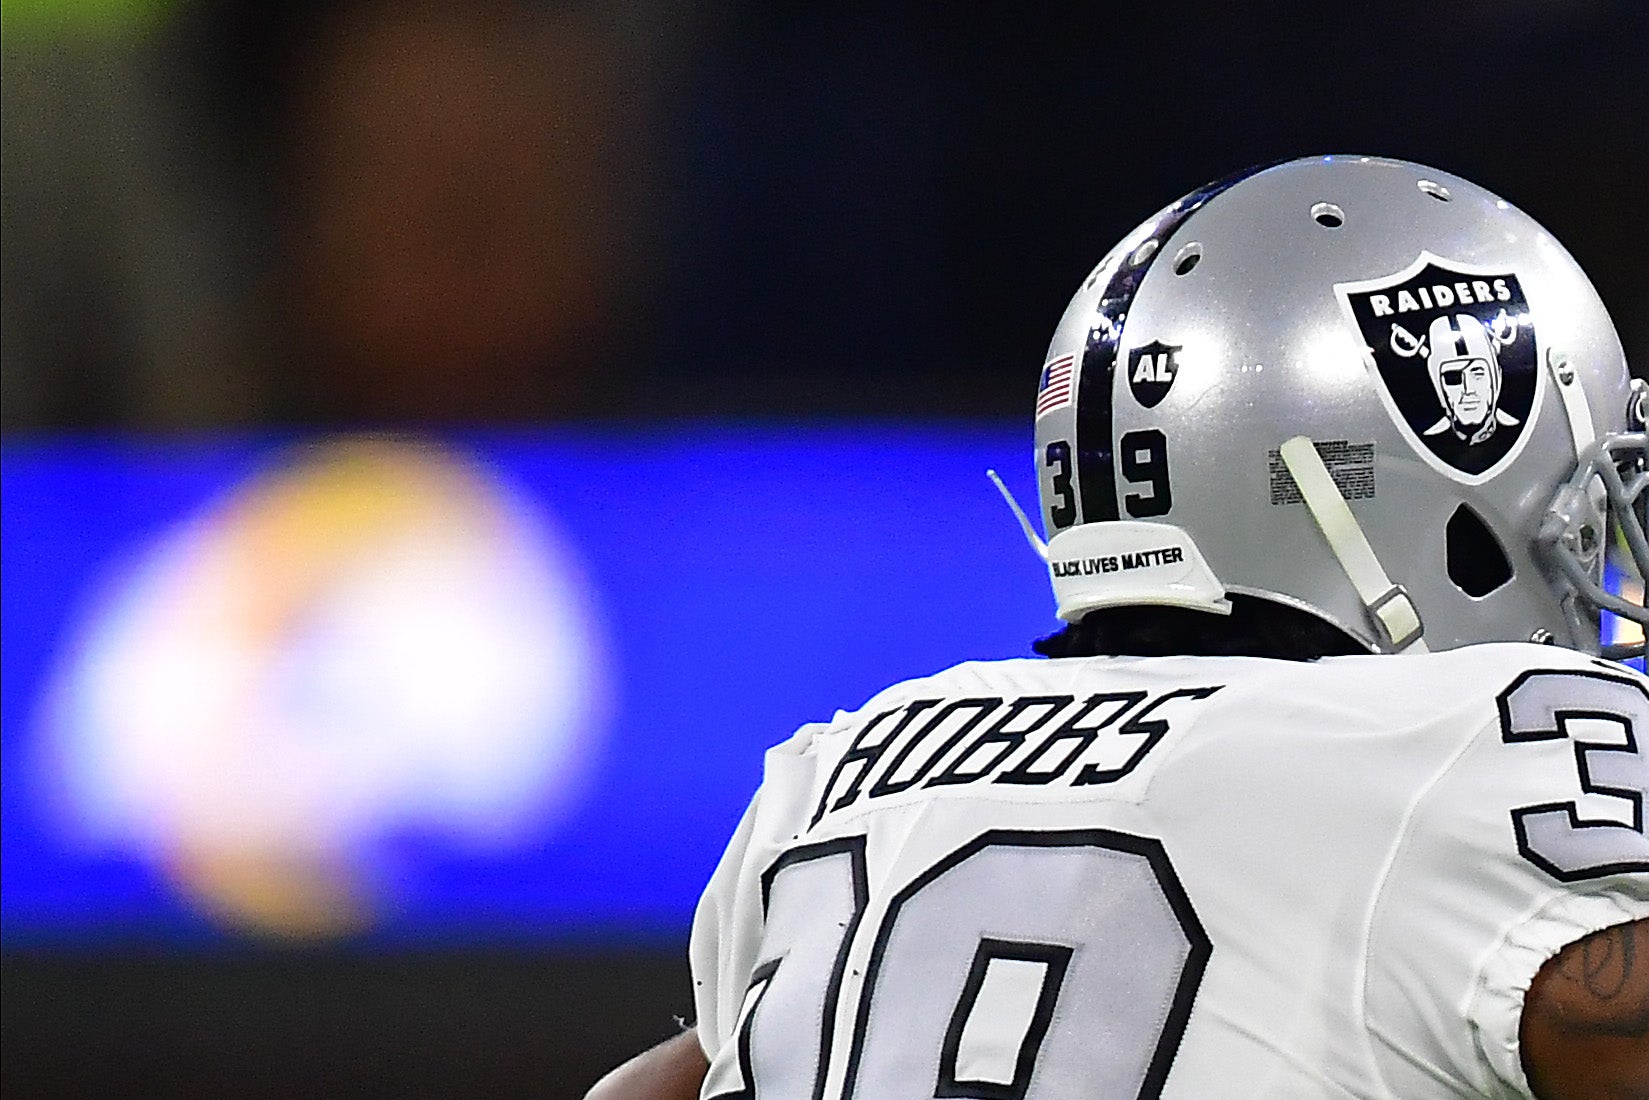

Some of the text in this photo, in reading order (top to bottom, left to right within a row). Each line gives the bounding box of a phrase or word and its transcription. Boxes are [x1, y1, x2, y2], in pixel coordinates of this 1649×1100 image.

[1369, 278, 1512, 318] RAIDERS
[1132, 353, 1173, 384] AL
[1053, 546, 1184, 578] BLACK LIVES MATTER
[806, 684, 1227, 834] HOBBS
